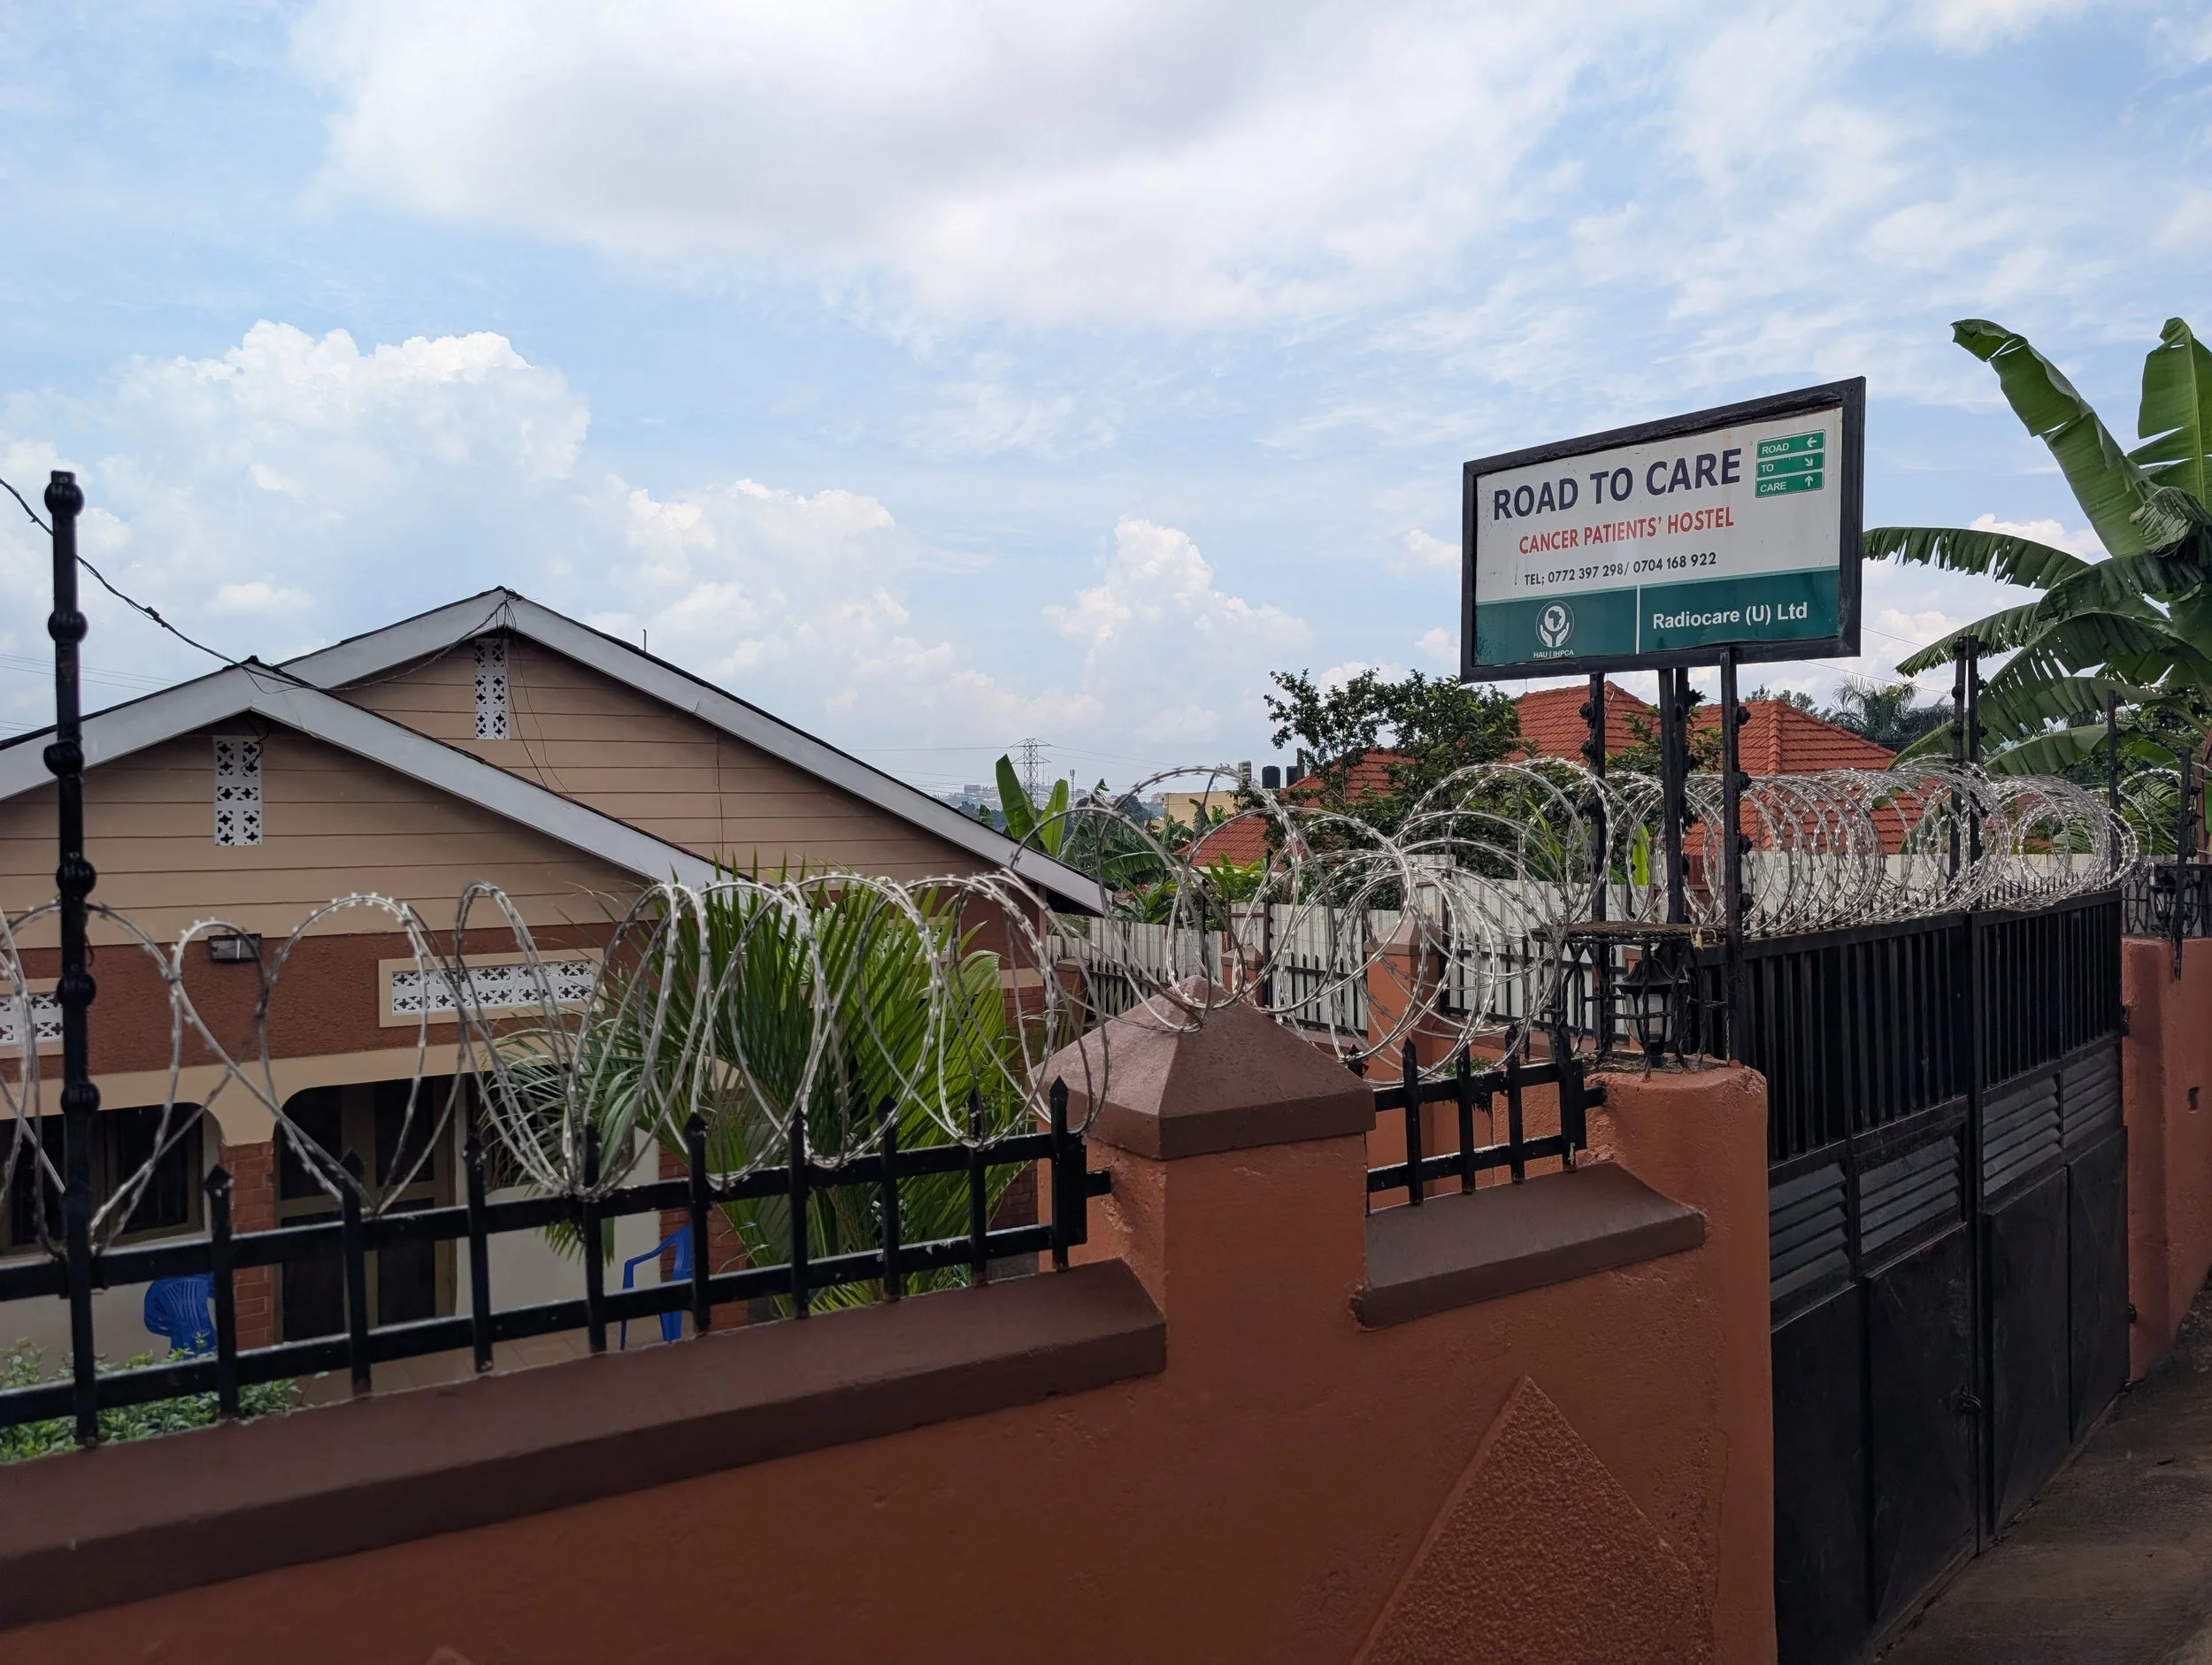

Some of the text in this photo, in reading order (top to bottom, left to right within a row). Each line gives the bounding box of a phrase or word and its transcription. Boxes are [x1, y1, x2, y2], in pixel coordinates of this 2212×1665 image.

[1762, 442, 1789, 455] ROAD
[1761, 464, 1774, 472] TO
[1494, 448, 1742, 520] ROAD TO CARE
[1760, 481, 1786, 493] CARE
[1518, 506, 1734, 555] CANCER PATIENTS' HOSTEL
[1524, 573, 1545, 586] TEL;
[1548, 569, 1575, 583] 0772
[1578, 565, 1599, 579] 397
[1633, 558, 1663, 573] 0704
[1666, 555, 1687, 570] 168
[1691, 551, 1717, 567] 922
[1653, 602, 1809, 629] Radiocare (U) Ltd
